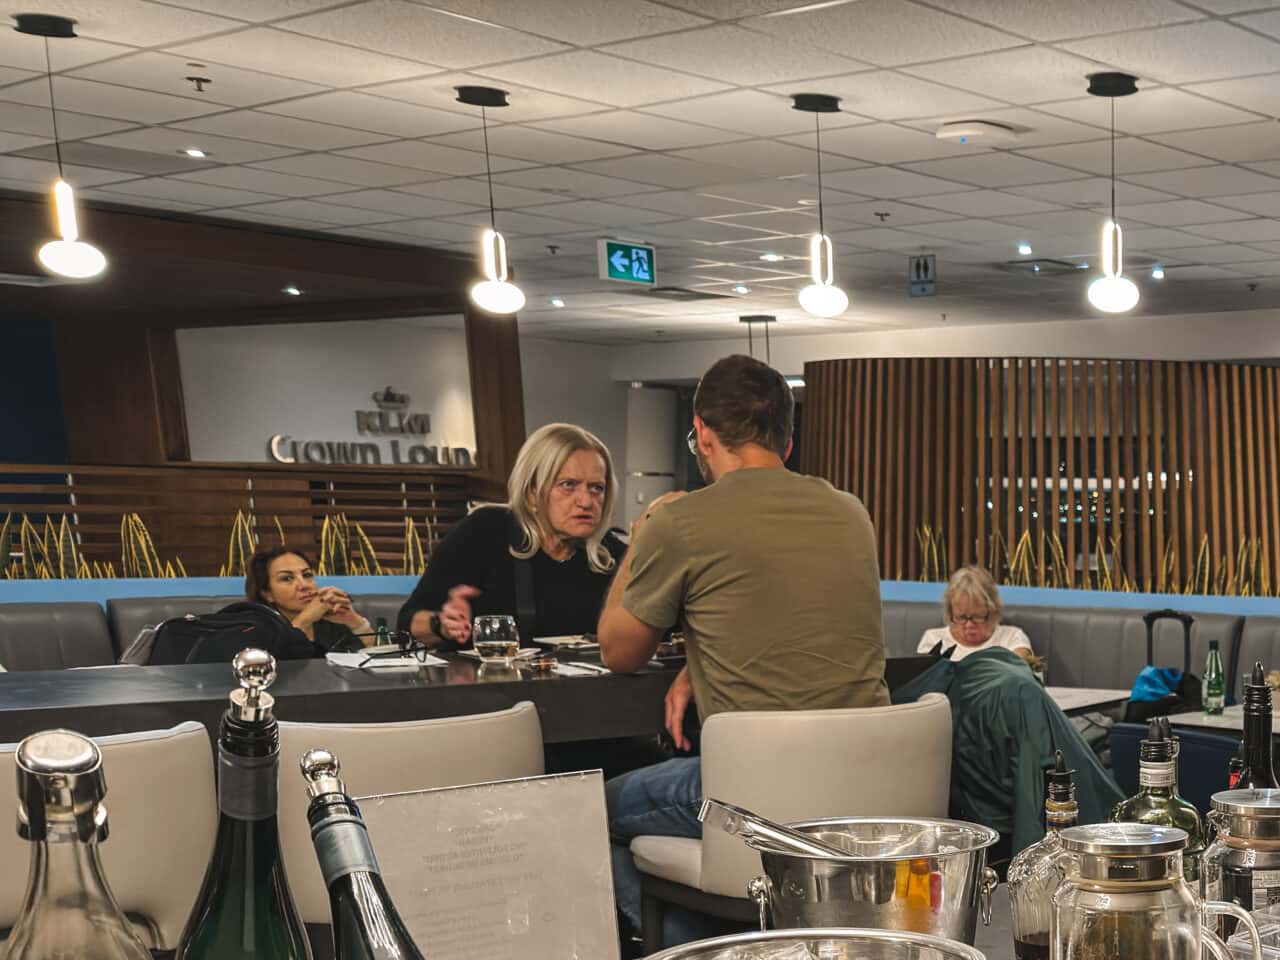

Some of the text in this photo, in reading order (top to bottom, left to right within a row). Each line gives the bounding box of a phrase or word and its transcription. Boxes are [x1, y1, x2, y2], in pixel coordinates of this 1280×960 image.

[354, 410, 431, 434] KLM
[268, 435, 477, 465] Crown Loun
